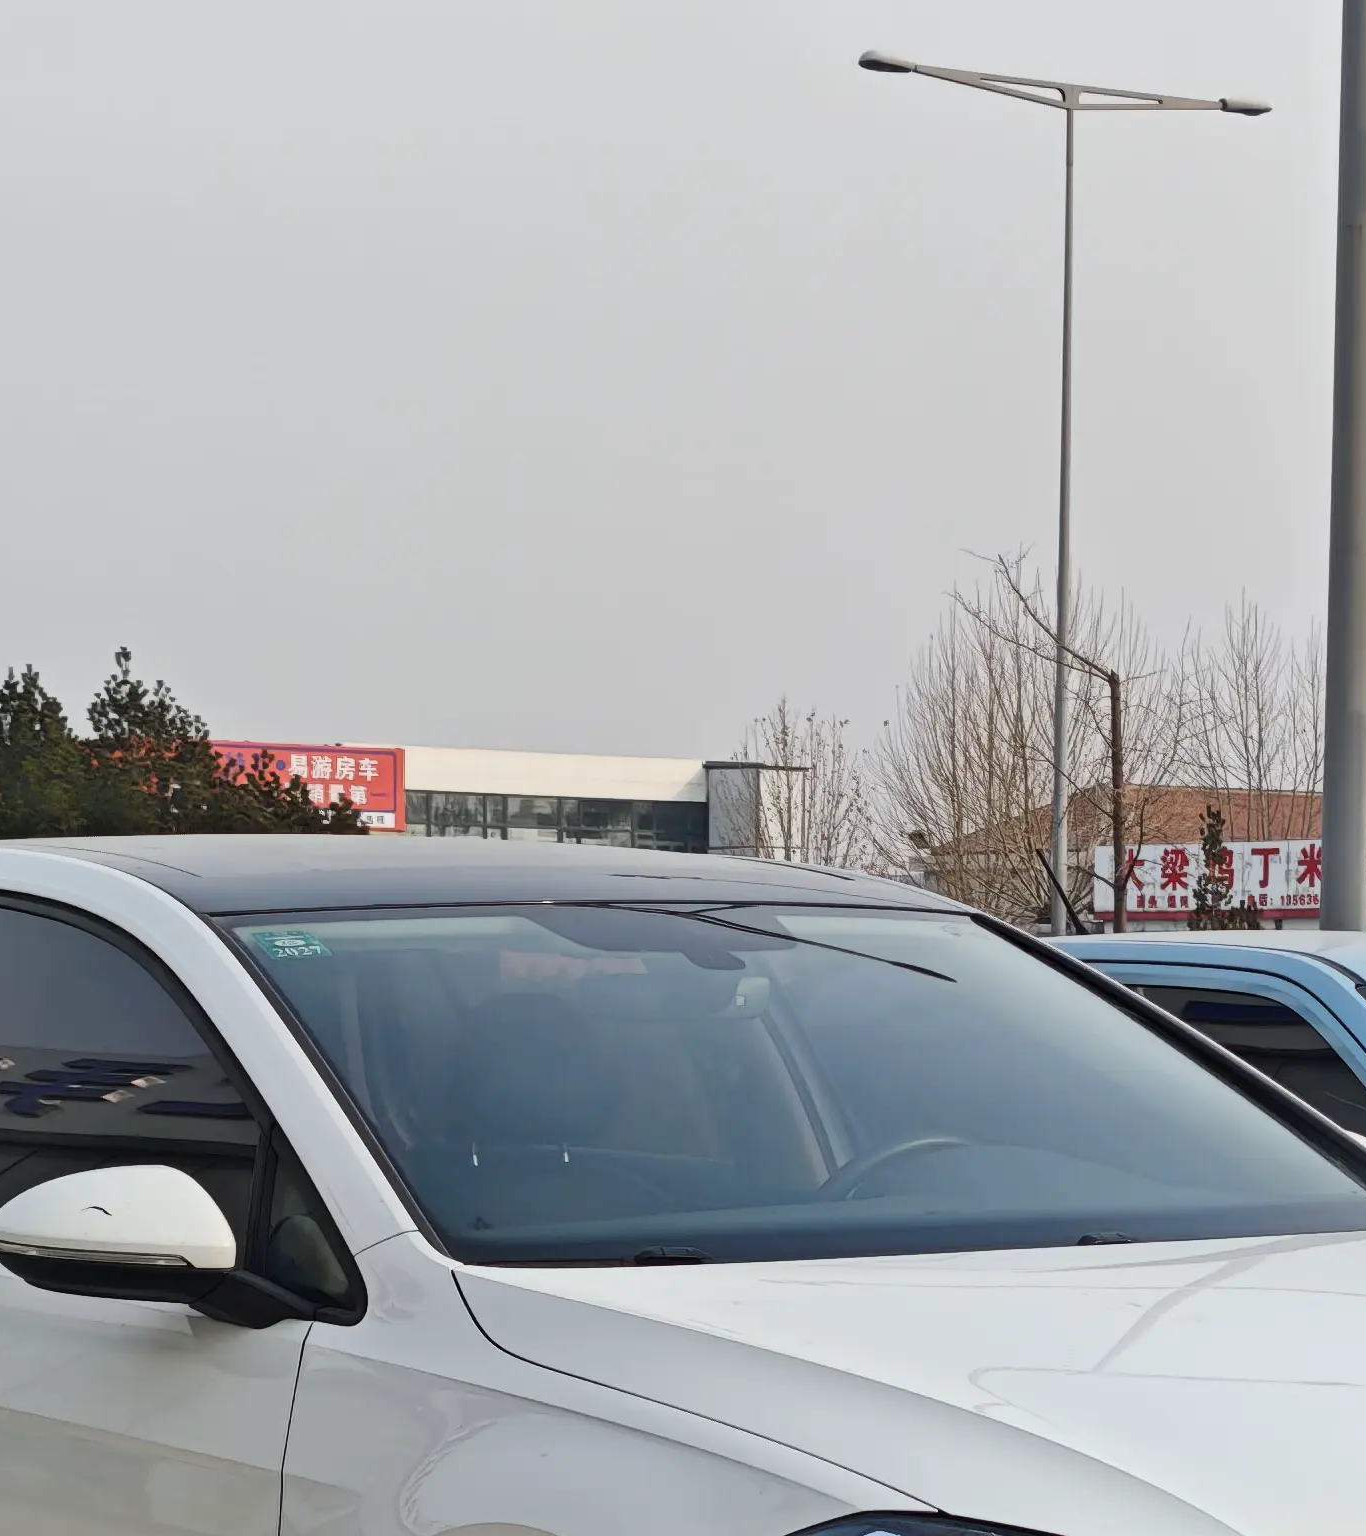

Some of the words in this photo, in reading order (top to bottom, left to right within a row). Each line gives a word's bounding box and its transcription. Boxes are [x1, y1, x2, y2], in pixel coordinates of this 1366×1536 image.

[288, 754, 380, 782] 易游房车
[272, 945, 322, 958] 2027
